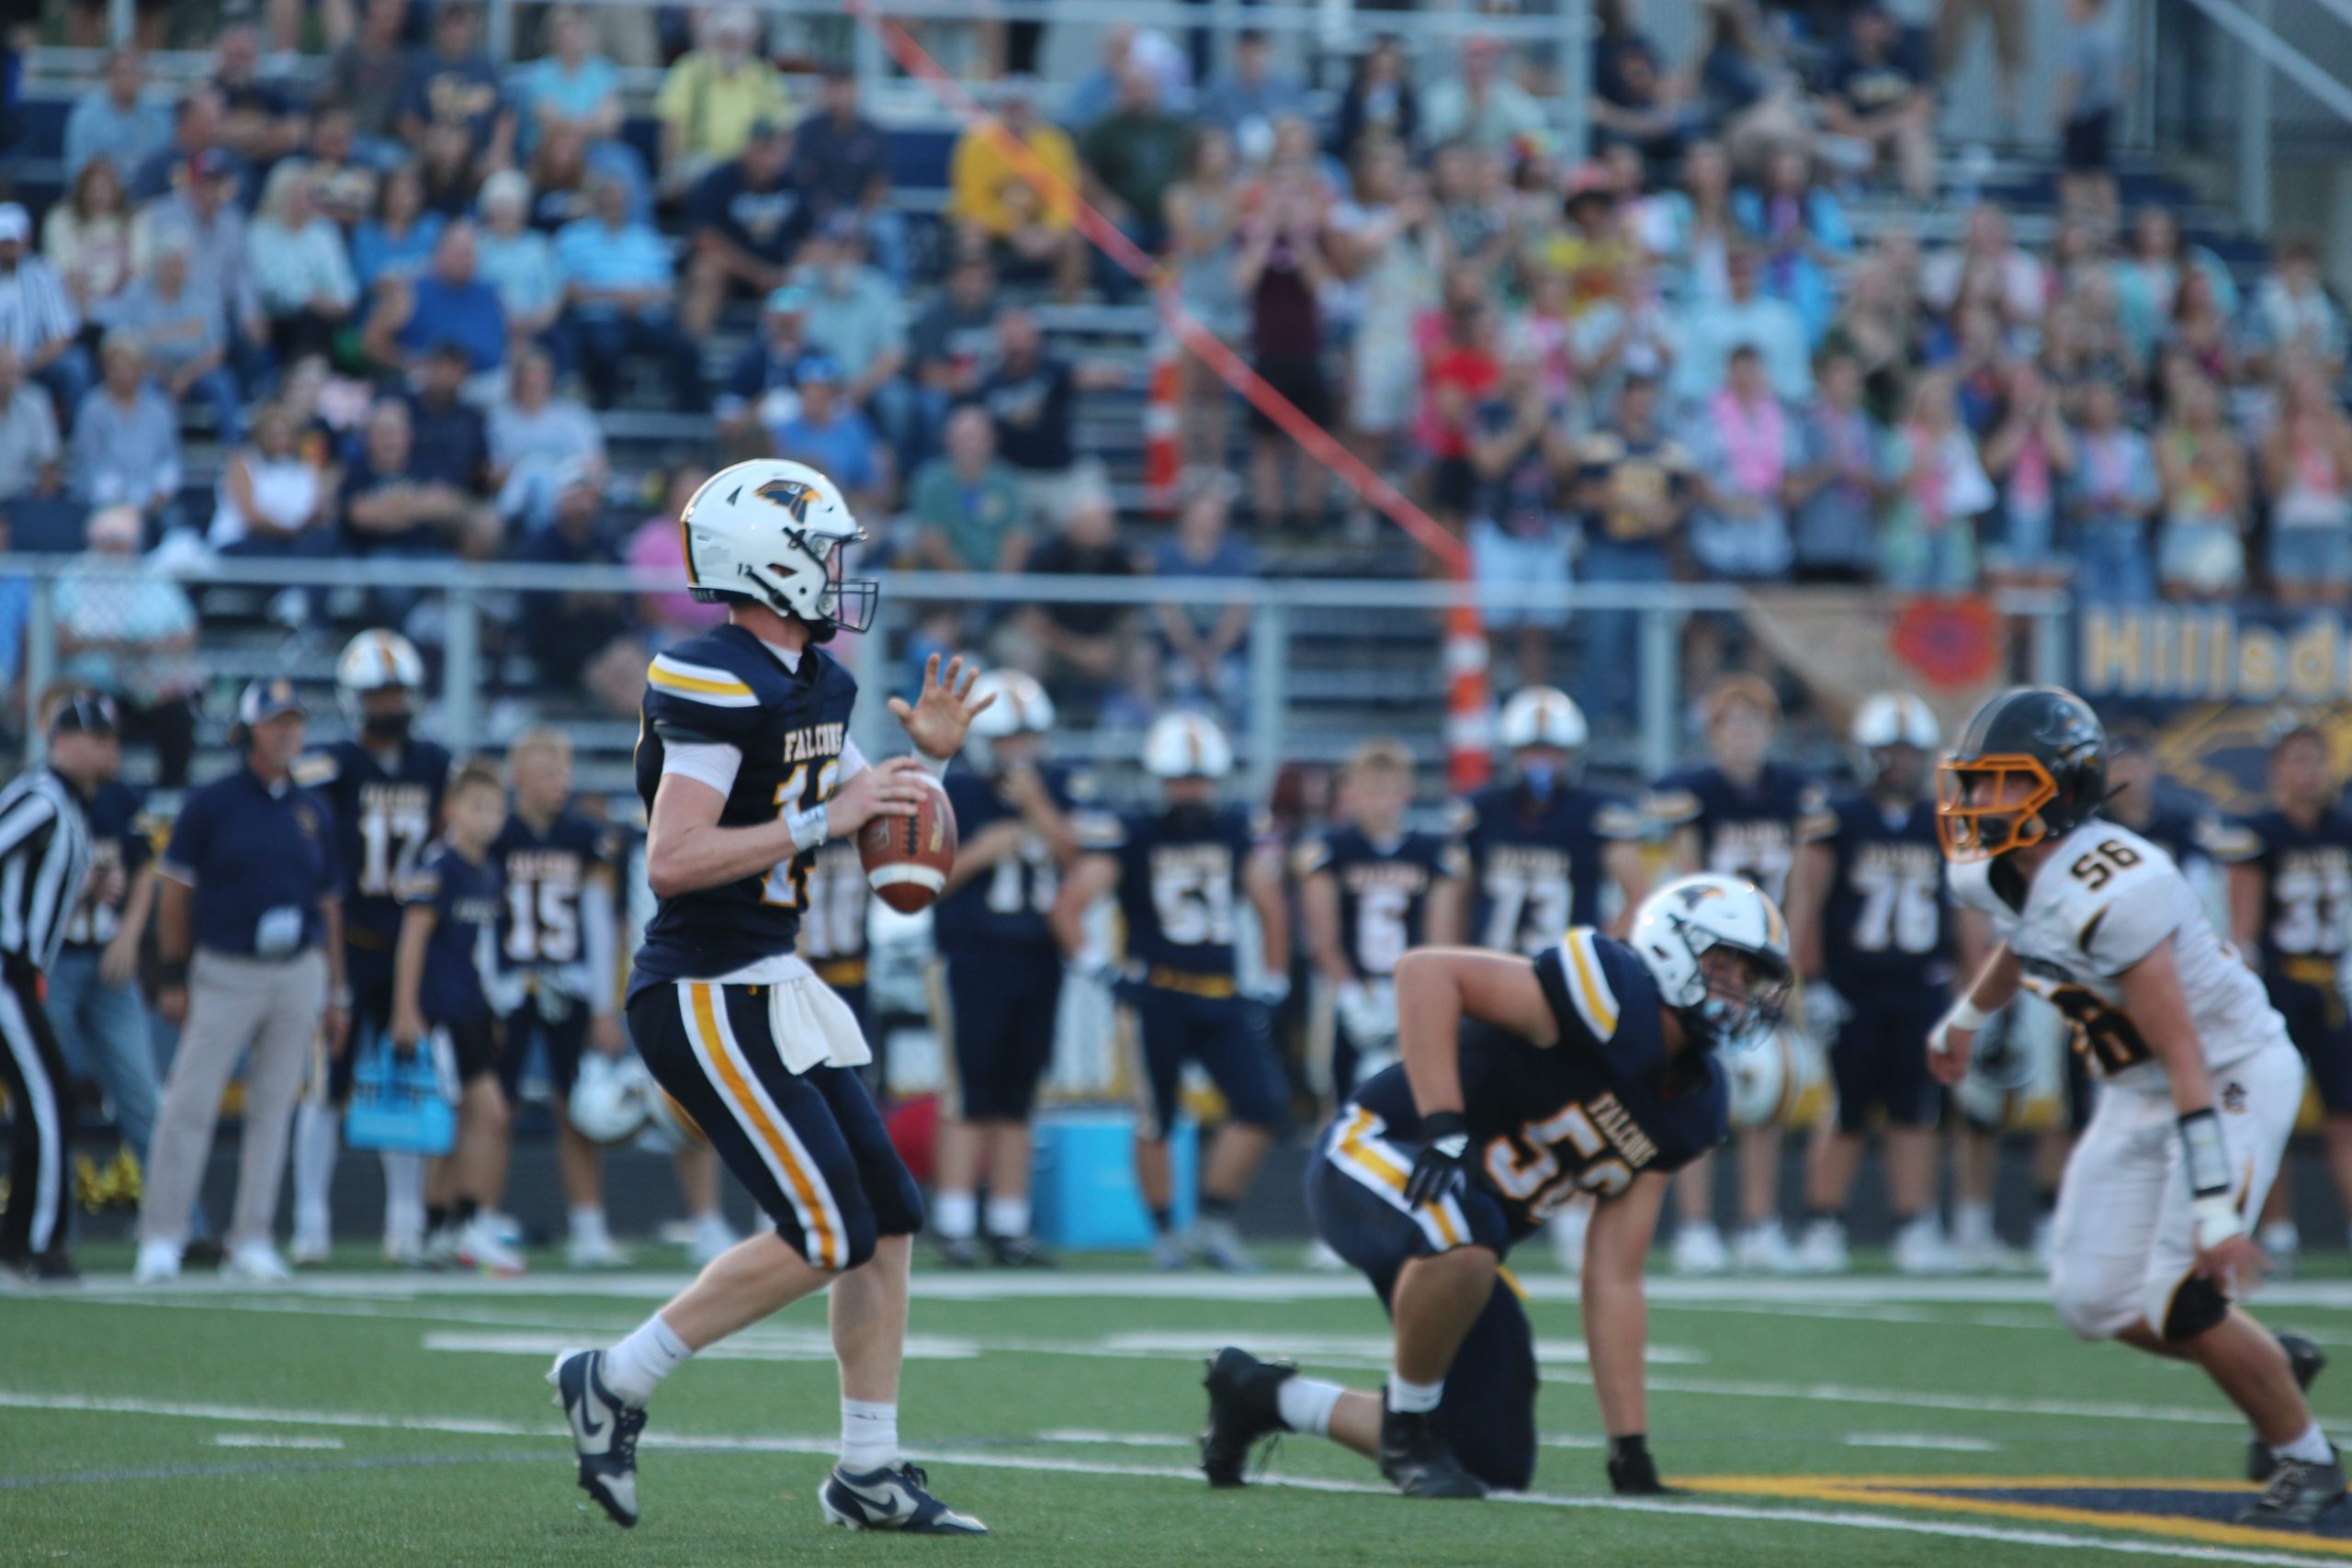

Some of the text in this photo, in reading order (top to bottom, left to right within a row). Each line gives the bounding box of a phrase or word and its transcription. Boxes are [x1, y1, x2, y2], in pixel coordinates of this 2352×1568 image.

[2082, 604, 2352, 702] Hillsd
[1850, 859, 1940, 953] 76
[2071, 840, 2143, 892] 56
[503, 875, 578, 962] 15
[1356, 884, 1409, 974] 6
[1483, 874, 1574, 958] 73
